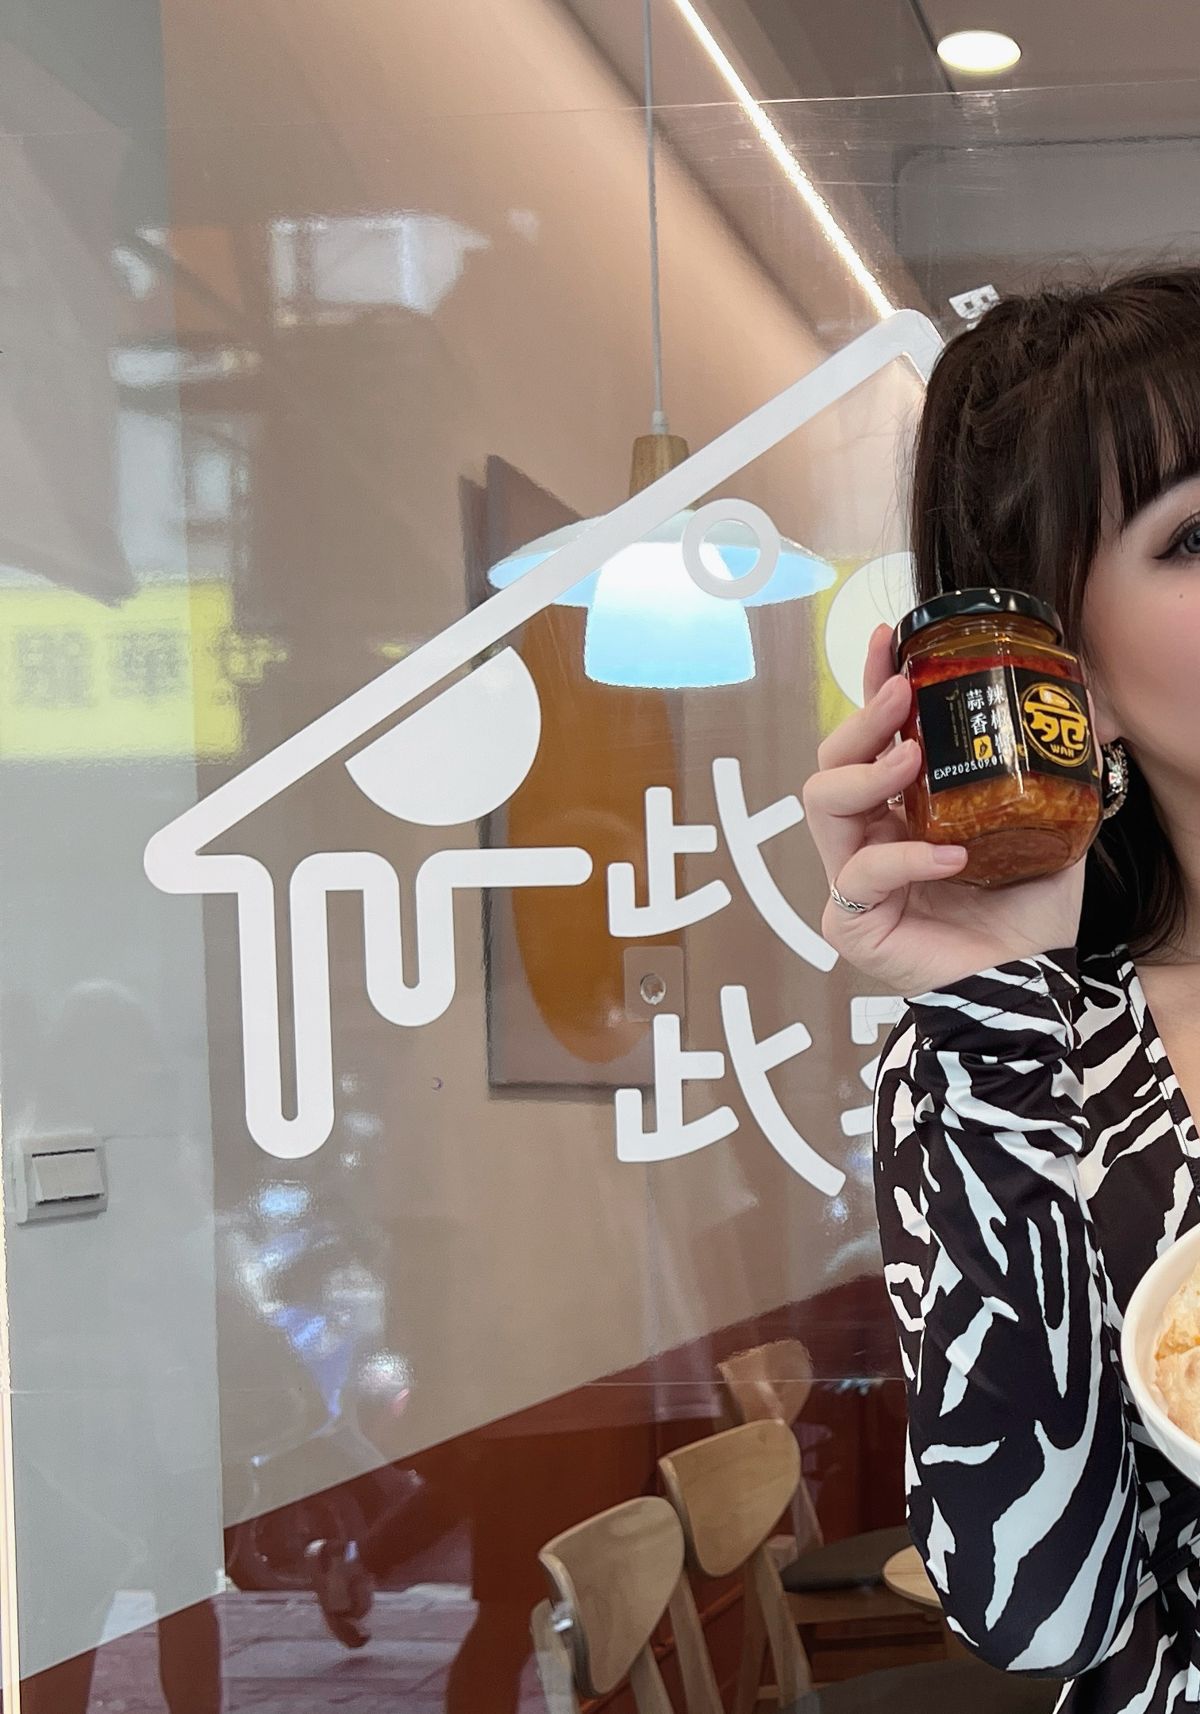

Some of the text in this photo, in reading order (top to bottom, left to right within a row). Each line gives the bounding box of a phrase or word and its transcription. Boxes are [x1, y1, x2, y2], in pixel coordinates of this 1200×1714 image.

[966, 688, 988, 735] 蒜香
[1049, 743, 1075, 758] WAN
[607, 757, 839, 972] 此
